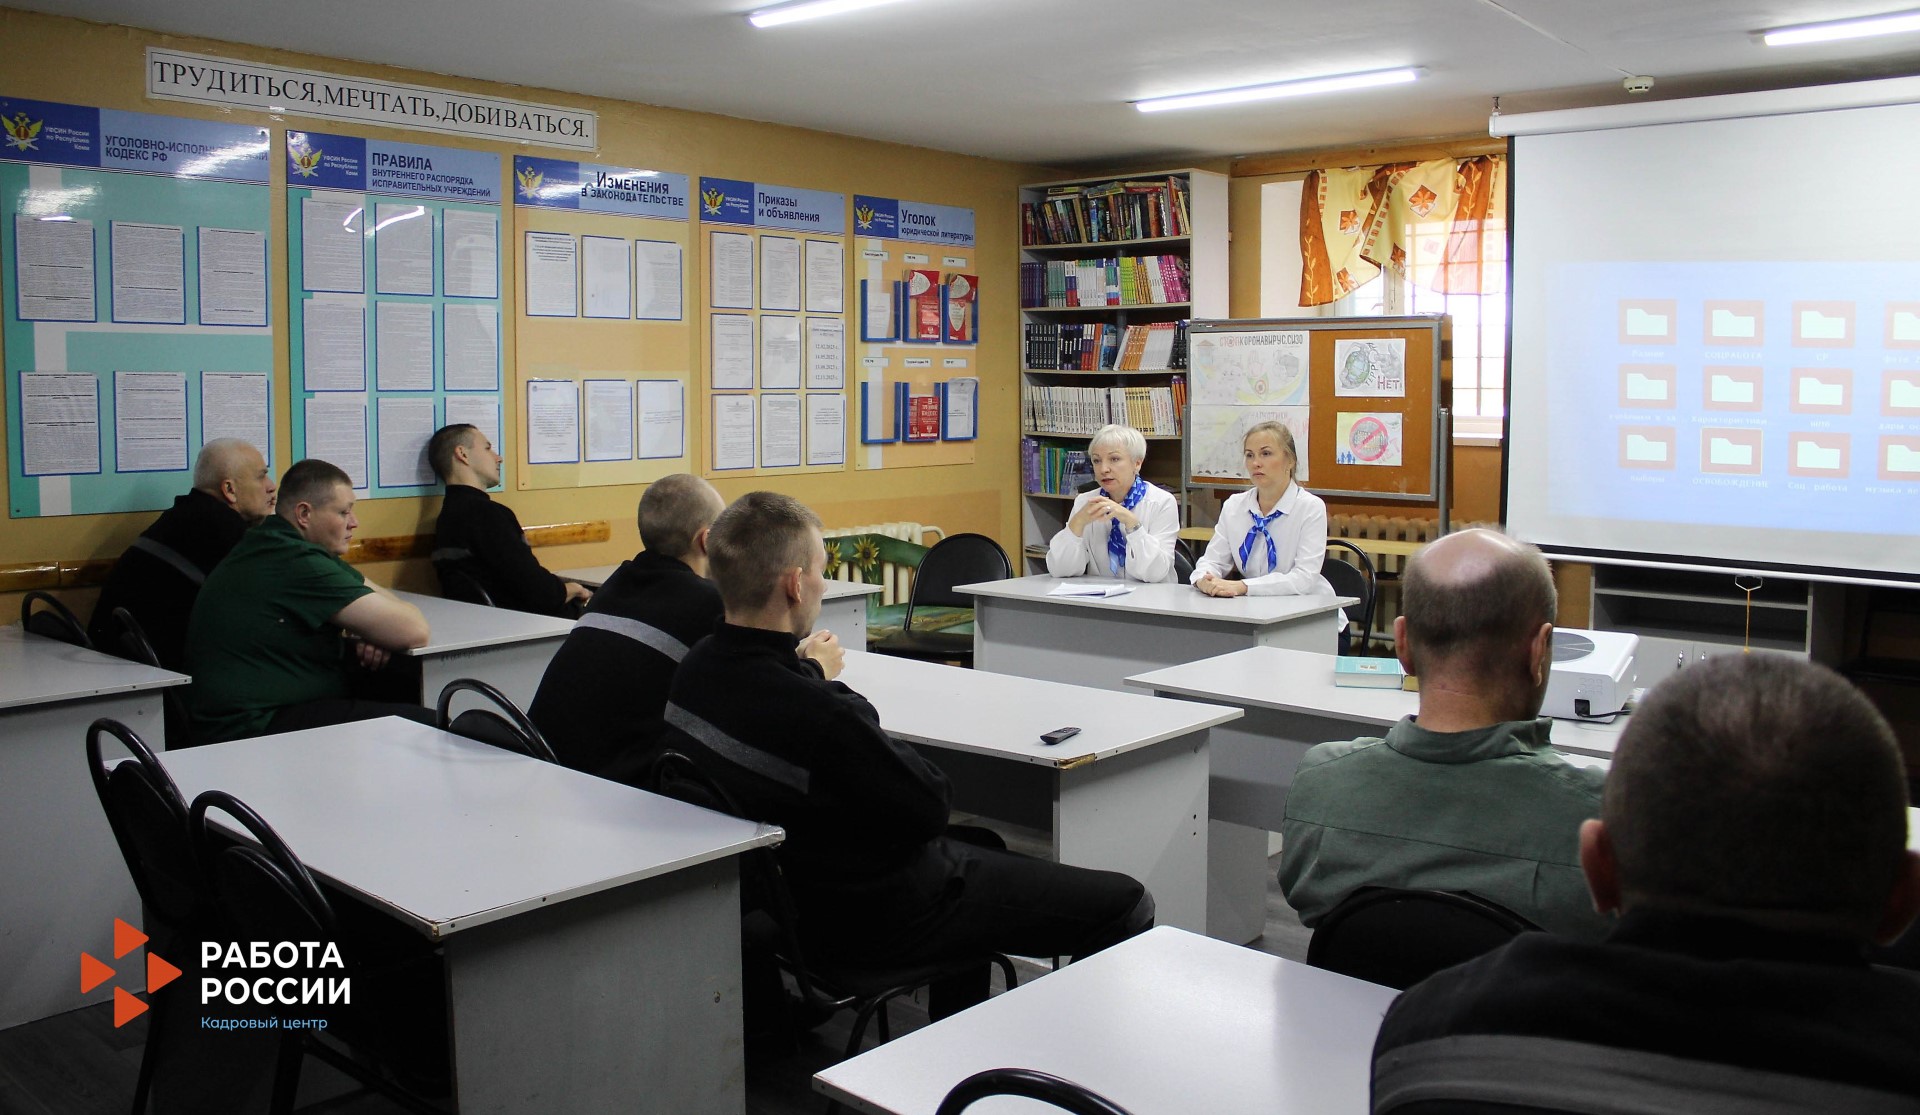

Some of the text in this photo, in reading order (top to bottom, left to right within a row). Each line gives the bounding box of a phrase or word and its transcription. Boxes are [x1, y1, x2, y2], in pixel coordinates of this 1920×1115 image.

[105, 149, 168, 162] КОДЕКС РФ
[372, 152, 433, 171] ПРАВИЛА
[372, 168, 474, 186] ВНУТРЕННЕГО РАСПОРЯДКА
[372, 179, 491, 198] ИСПРАВИТЕЛЬНЫХ УЧРЕЖДЕНИЙ
[590, 189, 684, 207] ЗАКОНОДАТЕЛЬСТВЕ
[758, 192, 798, 208] Приказы
[758, 207, 820, 223] и объявления
[901, 209, 936, 227] Уголок
[901, 227, 974, 242] юридической литературы
